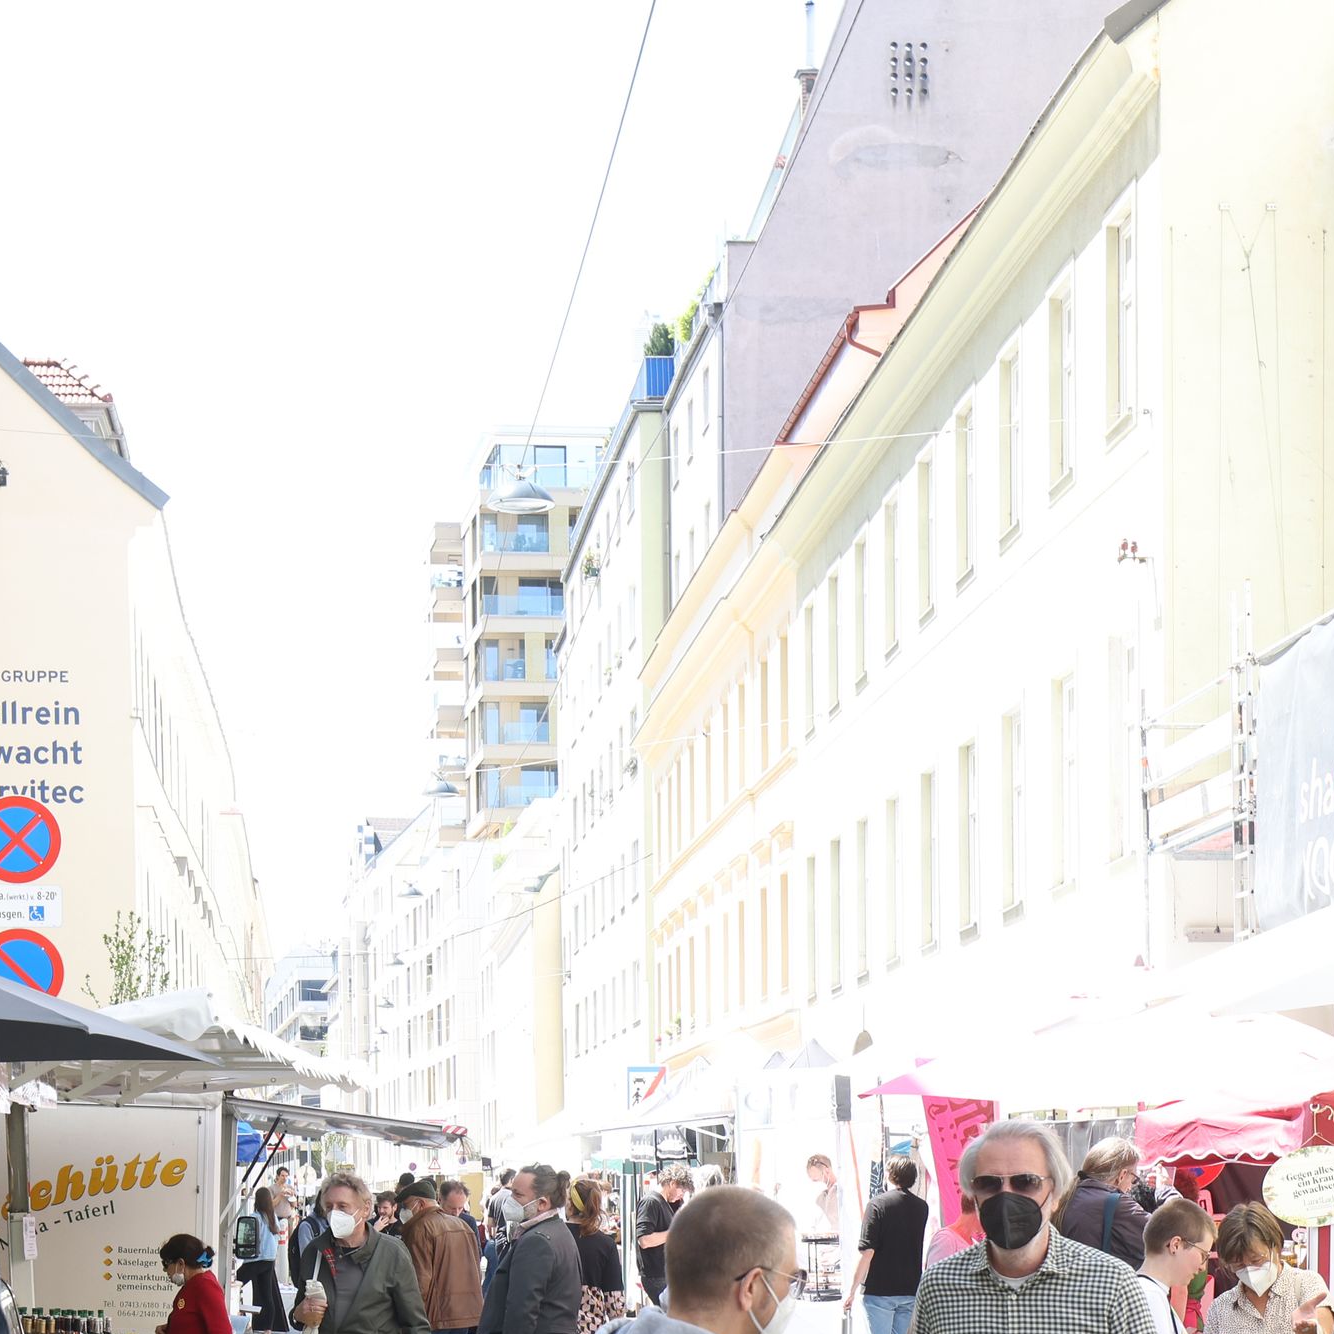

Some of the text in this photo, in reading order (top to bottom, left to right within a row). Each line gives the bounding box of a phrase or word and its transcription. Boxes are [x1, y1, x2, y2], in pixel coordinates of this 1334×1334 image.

[1, 671, 69, 683] GRUPPE
[1286, 1171, 1314, 1183] Gegen
[1313, 1164, 1334, 1177] alles
[1297, 1179, 1311, 1188] ein
[63, 1200, 115, 1224] Taferl
[117, 1258, 158, 1268] Käselager
[116, 1283, 173, 1292] gemeinschaft
[103, 1300, 117, 1308] Tel.
